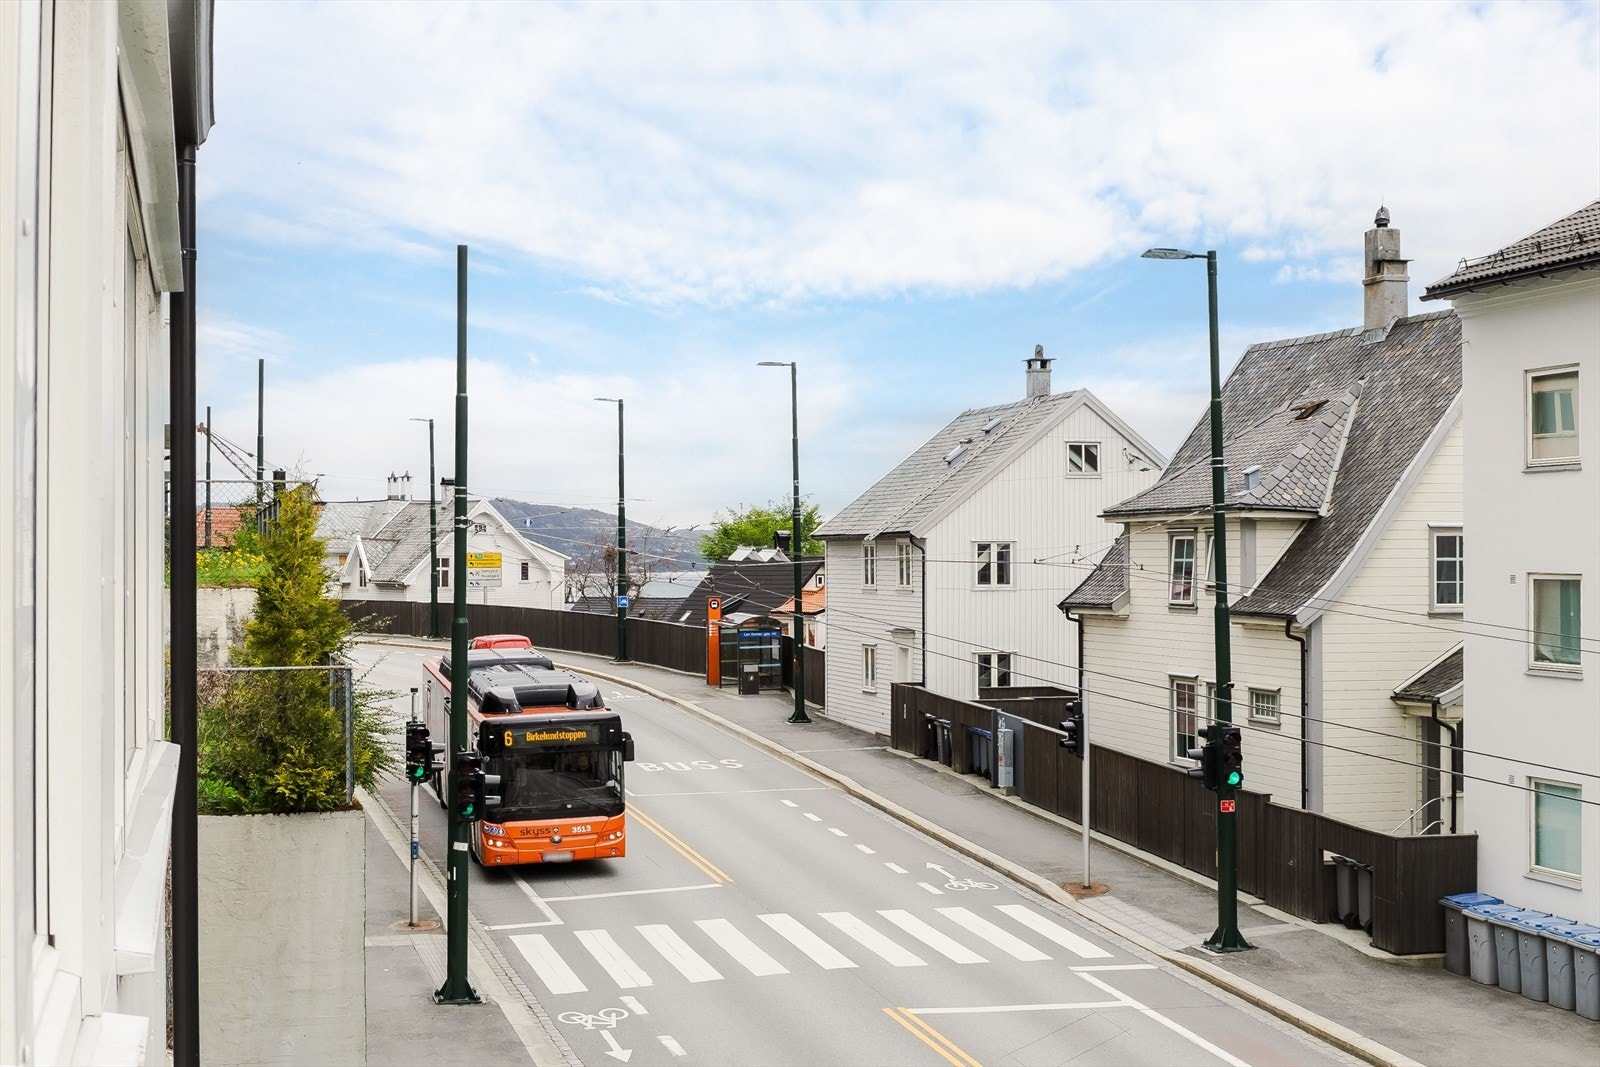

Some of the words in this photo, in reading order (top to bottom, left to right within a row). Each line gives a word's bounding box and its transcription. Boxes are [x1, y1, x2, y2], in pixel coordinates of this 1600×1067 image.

[504, 731, 513, 746] 6
[526, 731, 587, 742] Birkelundstoppen
[635, 759, 745, 772] BUSS
[520, 827, 551, 836] skyss
[571, 825, 592, 833] 3513
